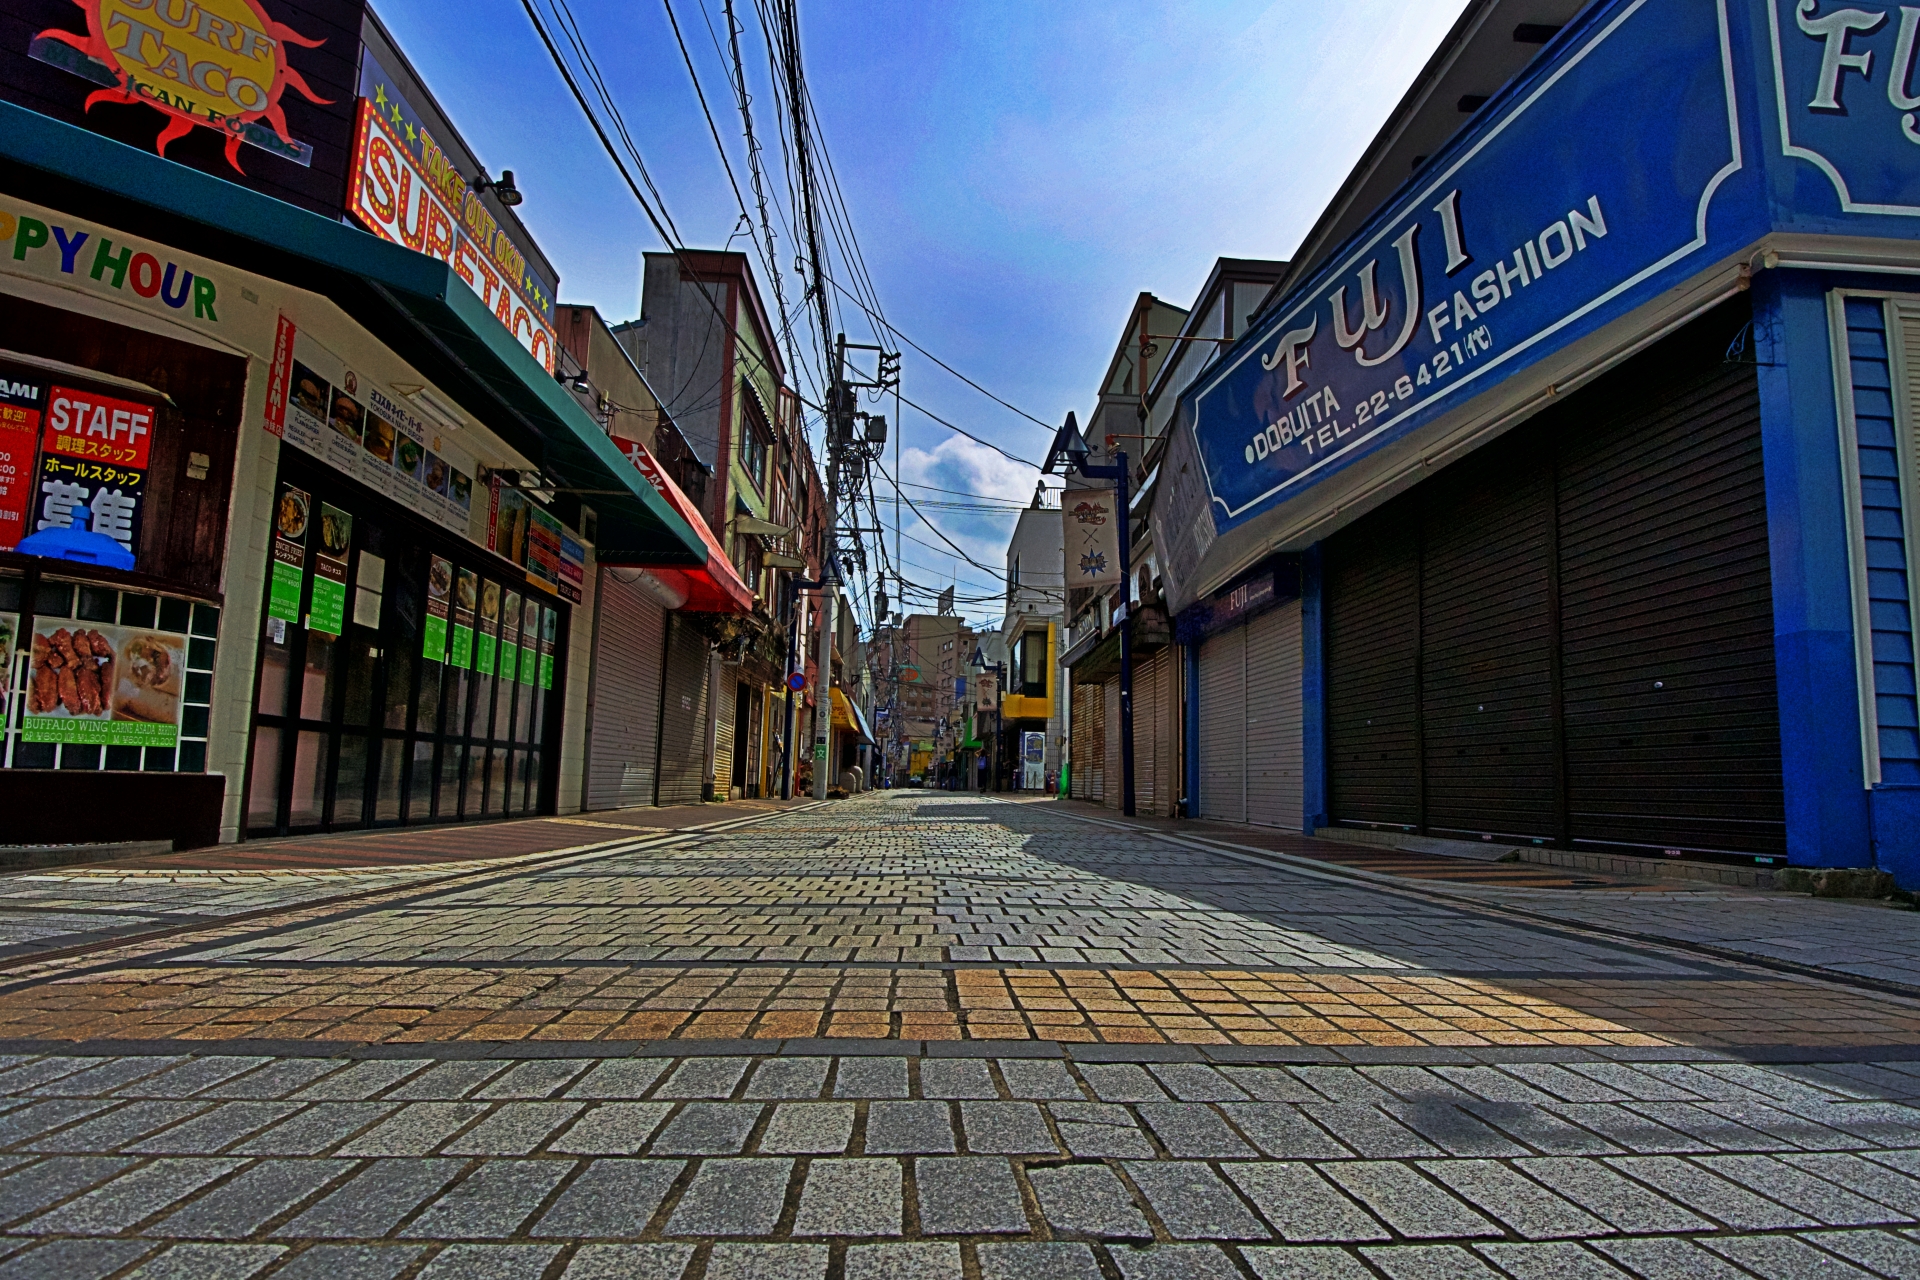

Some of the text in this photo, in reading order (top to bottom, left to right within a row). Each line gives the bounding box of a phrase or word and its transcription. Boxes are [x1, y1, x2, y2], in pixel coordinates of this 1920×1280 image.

[107, 10, 268, 112] TACO
[206, 107, 302, 159] FOODS
[419, 126, 465, 208] TAKE
[465, 189, 497, 248] OUT
[89, 237, 218, 322] HOUR
[1261, 189, 1475, 400] FUJI
[1427, 195, 1608, 344] FASHION
[269, 317, 289, 422] TSUNAMI
[51, 397, 149, 445] STAFF
[1254, 385, 1341, 462] DOBUITA
[45, 458, 141, 487] ホールスタッフ
[56, 434, 137, 462] 調理スタッフ
[1230, 583, 1248, 611] FUJI
[25, 718, 109, 733] BUFFALO WING
[111, 721, 134, 734] CARNE
[134, 723, 156, 735] ASADA
[113, 734, 120, 744] M
[145, 736, 150, 745] L
